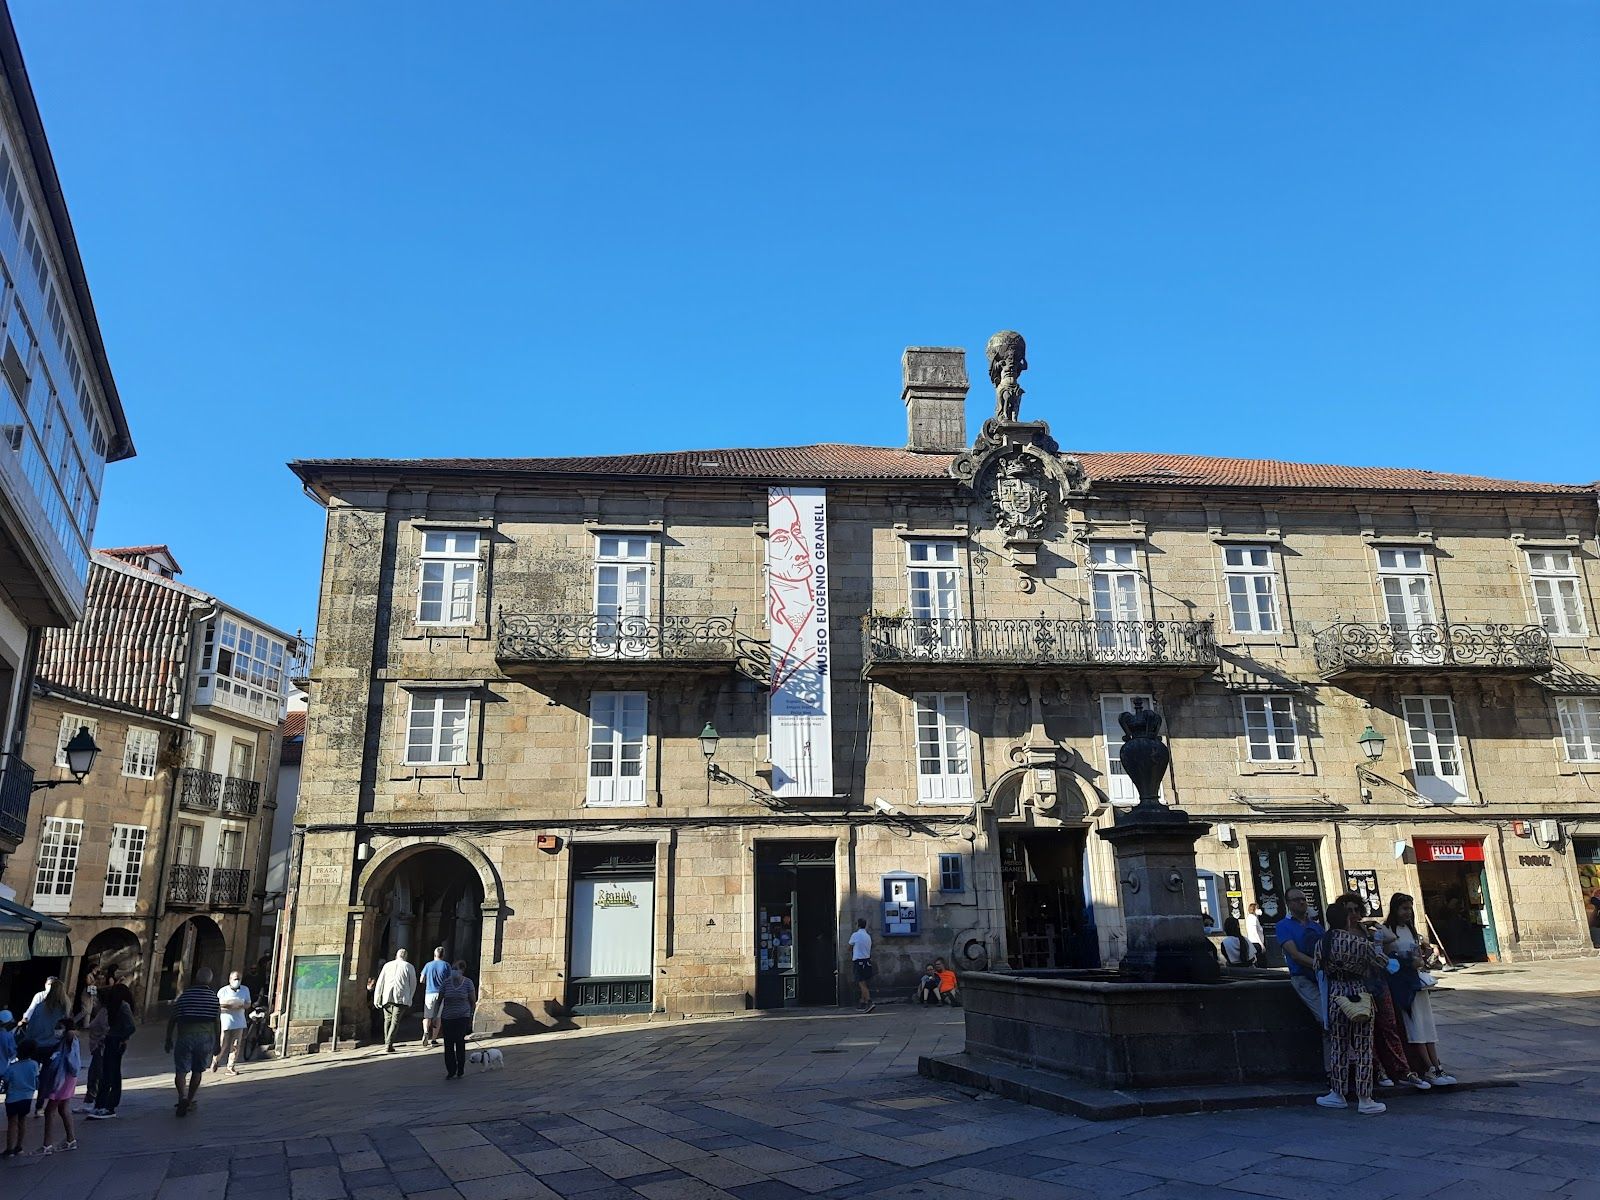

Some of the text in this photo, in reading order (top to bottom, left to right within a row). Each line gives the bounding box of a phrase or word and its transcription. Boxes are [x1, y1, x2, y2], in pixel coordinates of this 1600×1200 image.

[814, 503, 828, 676] MUSEO EUGENIO GRANELL
[1433, 845, 1463, 855] FROIZ
[1518, 855, 1553, 867] FROIZ
